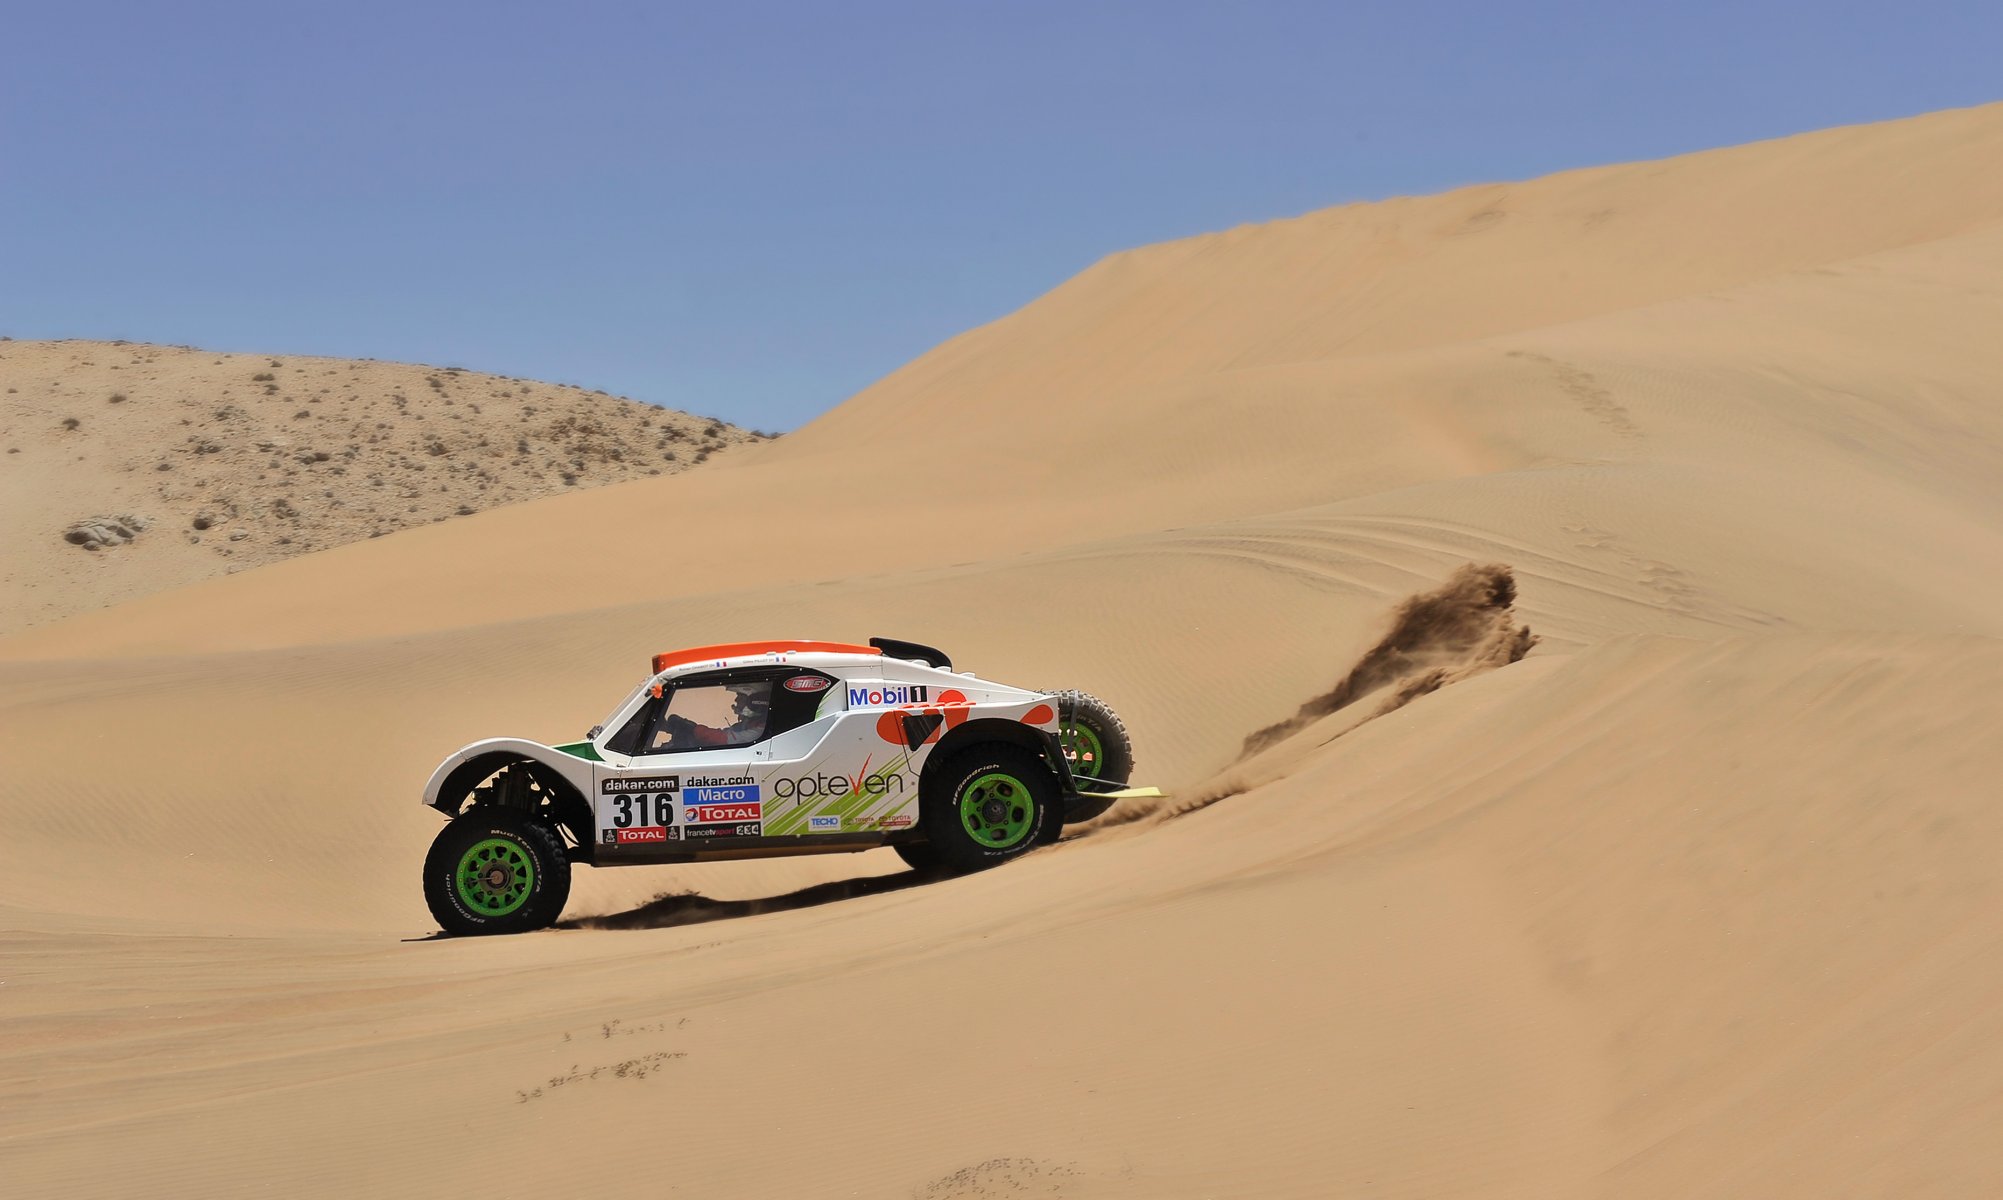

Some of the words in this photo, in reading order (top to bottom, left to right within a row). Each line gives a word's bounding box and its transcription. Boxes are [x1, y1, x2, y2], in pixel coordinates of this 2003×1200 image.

[850, 687, 908, 706] Mobil
[912, 686, 925, 703] 1
[605, 779, 675, 791] dakar.com
[687, 776, 755, 787] dakar.com
[698, 789, 746, 802] Macro
[613, 793, 674, 828] 316
[701, 808, 759, 820] TOTAL
[811, 817, 839, 827] TECHO
[619, 830, 665, 841] TOTAL
